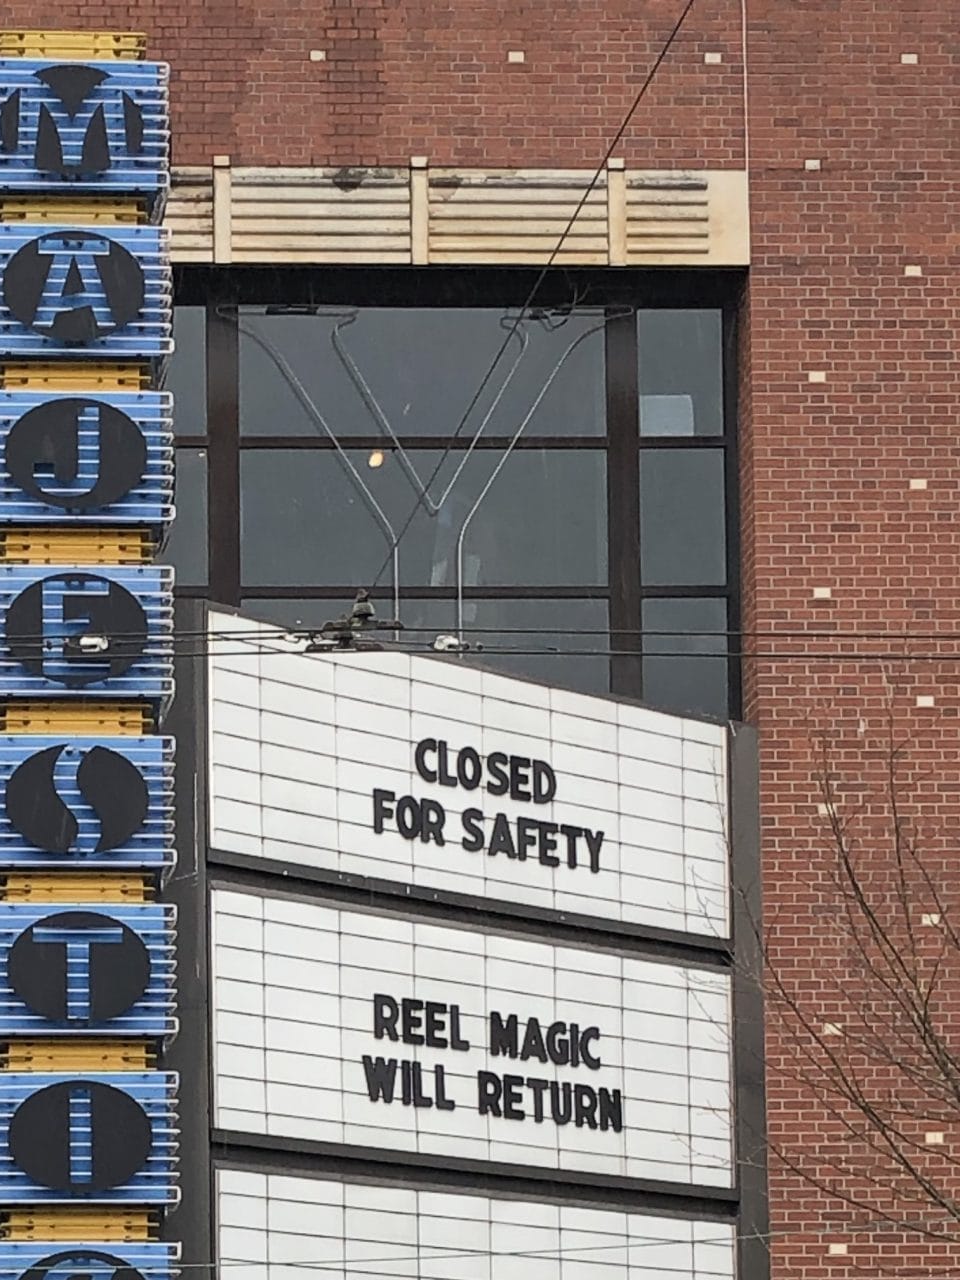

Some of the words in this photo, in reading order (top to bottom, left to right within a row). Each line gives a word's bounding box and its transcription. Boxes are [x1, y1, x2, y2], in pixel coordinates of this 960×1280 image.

[414, 738, 557, 804] CLOSED
[372, 788, 446, 847] FOR
[461, 807, 604, 873] SAFETY
[373, 993, 470, 1052] REEL
[489, 1011, 601, 1071] MAGIC
[362, 1055, 456, 1111] WILL
[477, 1070, 623, 1133] RETURN
